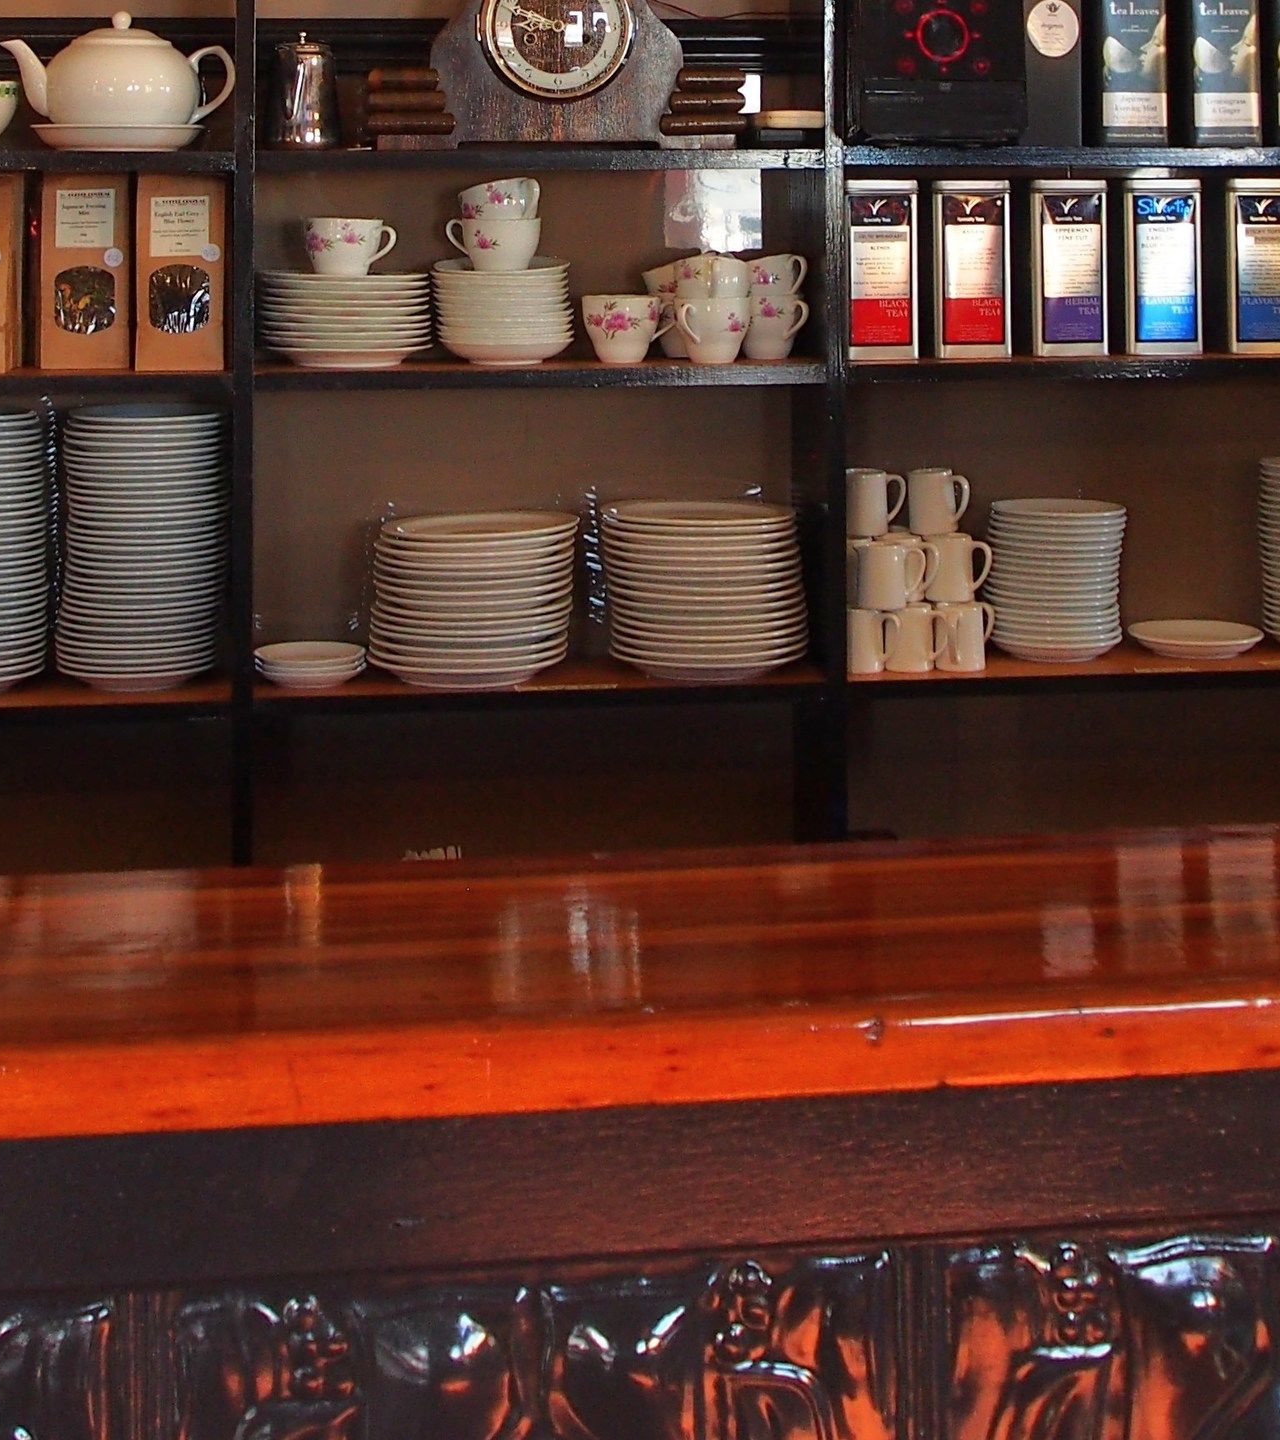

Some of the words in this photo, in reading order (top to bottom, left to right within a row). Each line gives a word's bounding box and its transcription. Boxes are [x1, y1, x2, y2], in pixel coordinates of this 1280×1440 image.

[879, 299, 908, 308] BLACK
[972, 299, 1001, 308] BLACK
[1065, 297, 1099, 306] HERBAL
